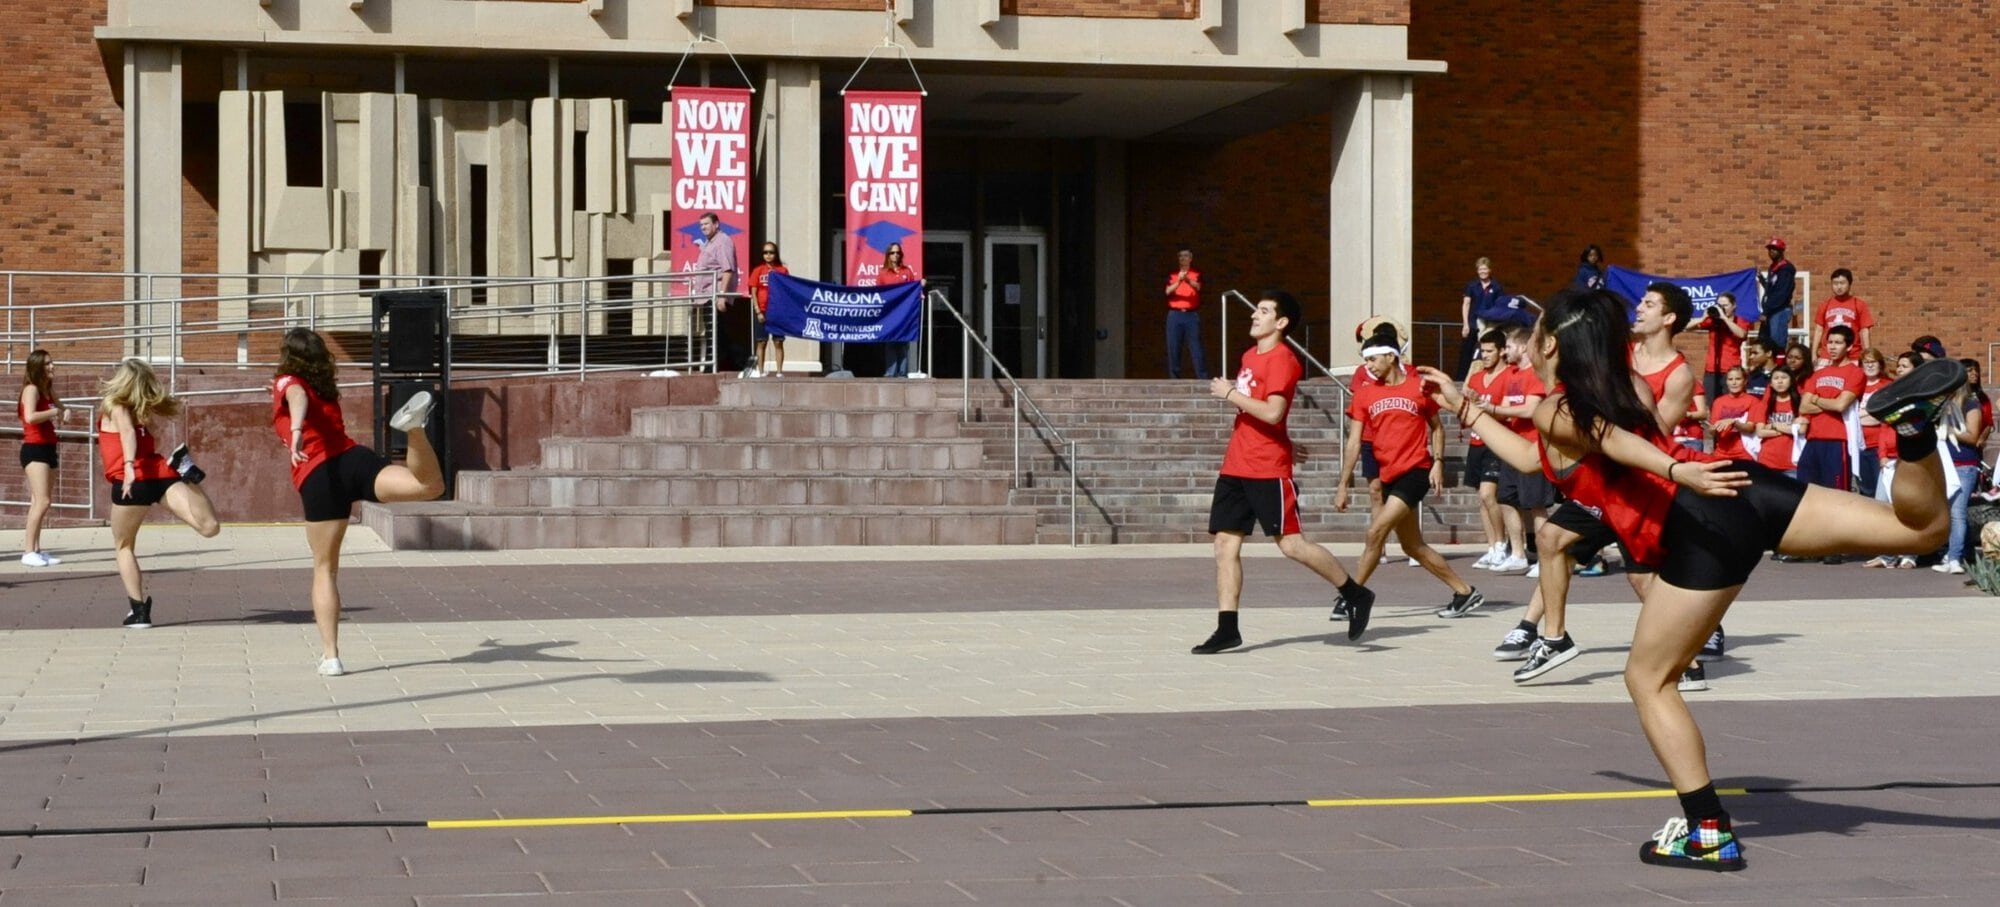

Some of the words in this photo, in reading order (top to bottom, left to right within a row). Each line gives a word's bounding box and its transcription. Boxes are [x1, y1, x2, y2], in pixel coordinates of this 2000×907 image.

[677, 99, 745, 131] NOW
[850, 103, 917, 134] NOW
[675, 132, 746, 176] WE
[848, 136, 918, 179] WE
[675, 178, 746, 213] CAN!
[849, 181, 919, 216] CAN!
[823, 323, 838, 332] THE
[839, 324, 884, 333] UNIVERSITY
[827, 332, 839, 340] OF
[1369, 396, 1418, 421] ARIZONA
